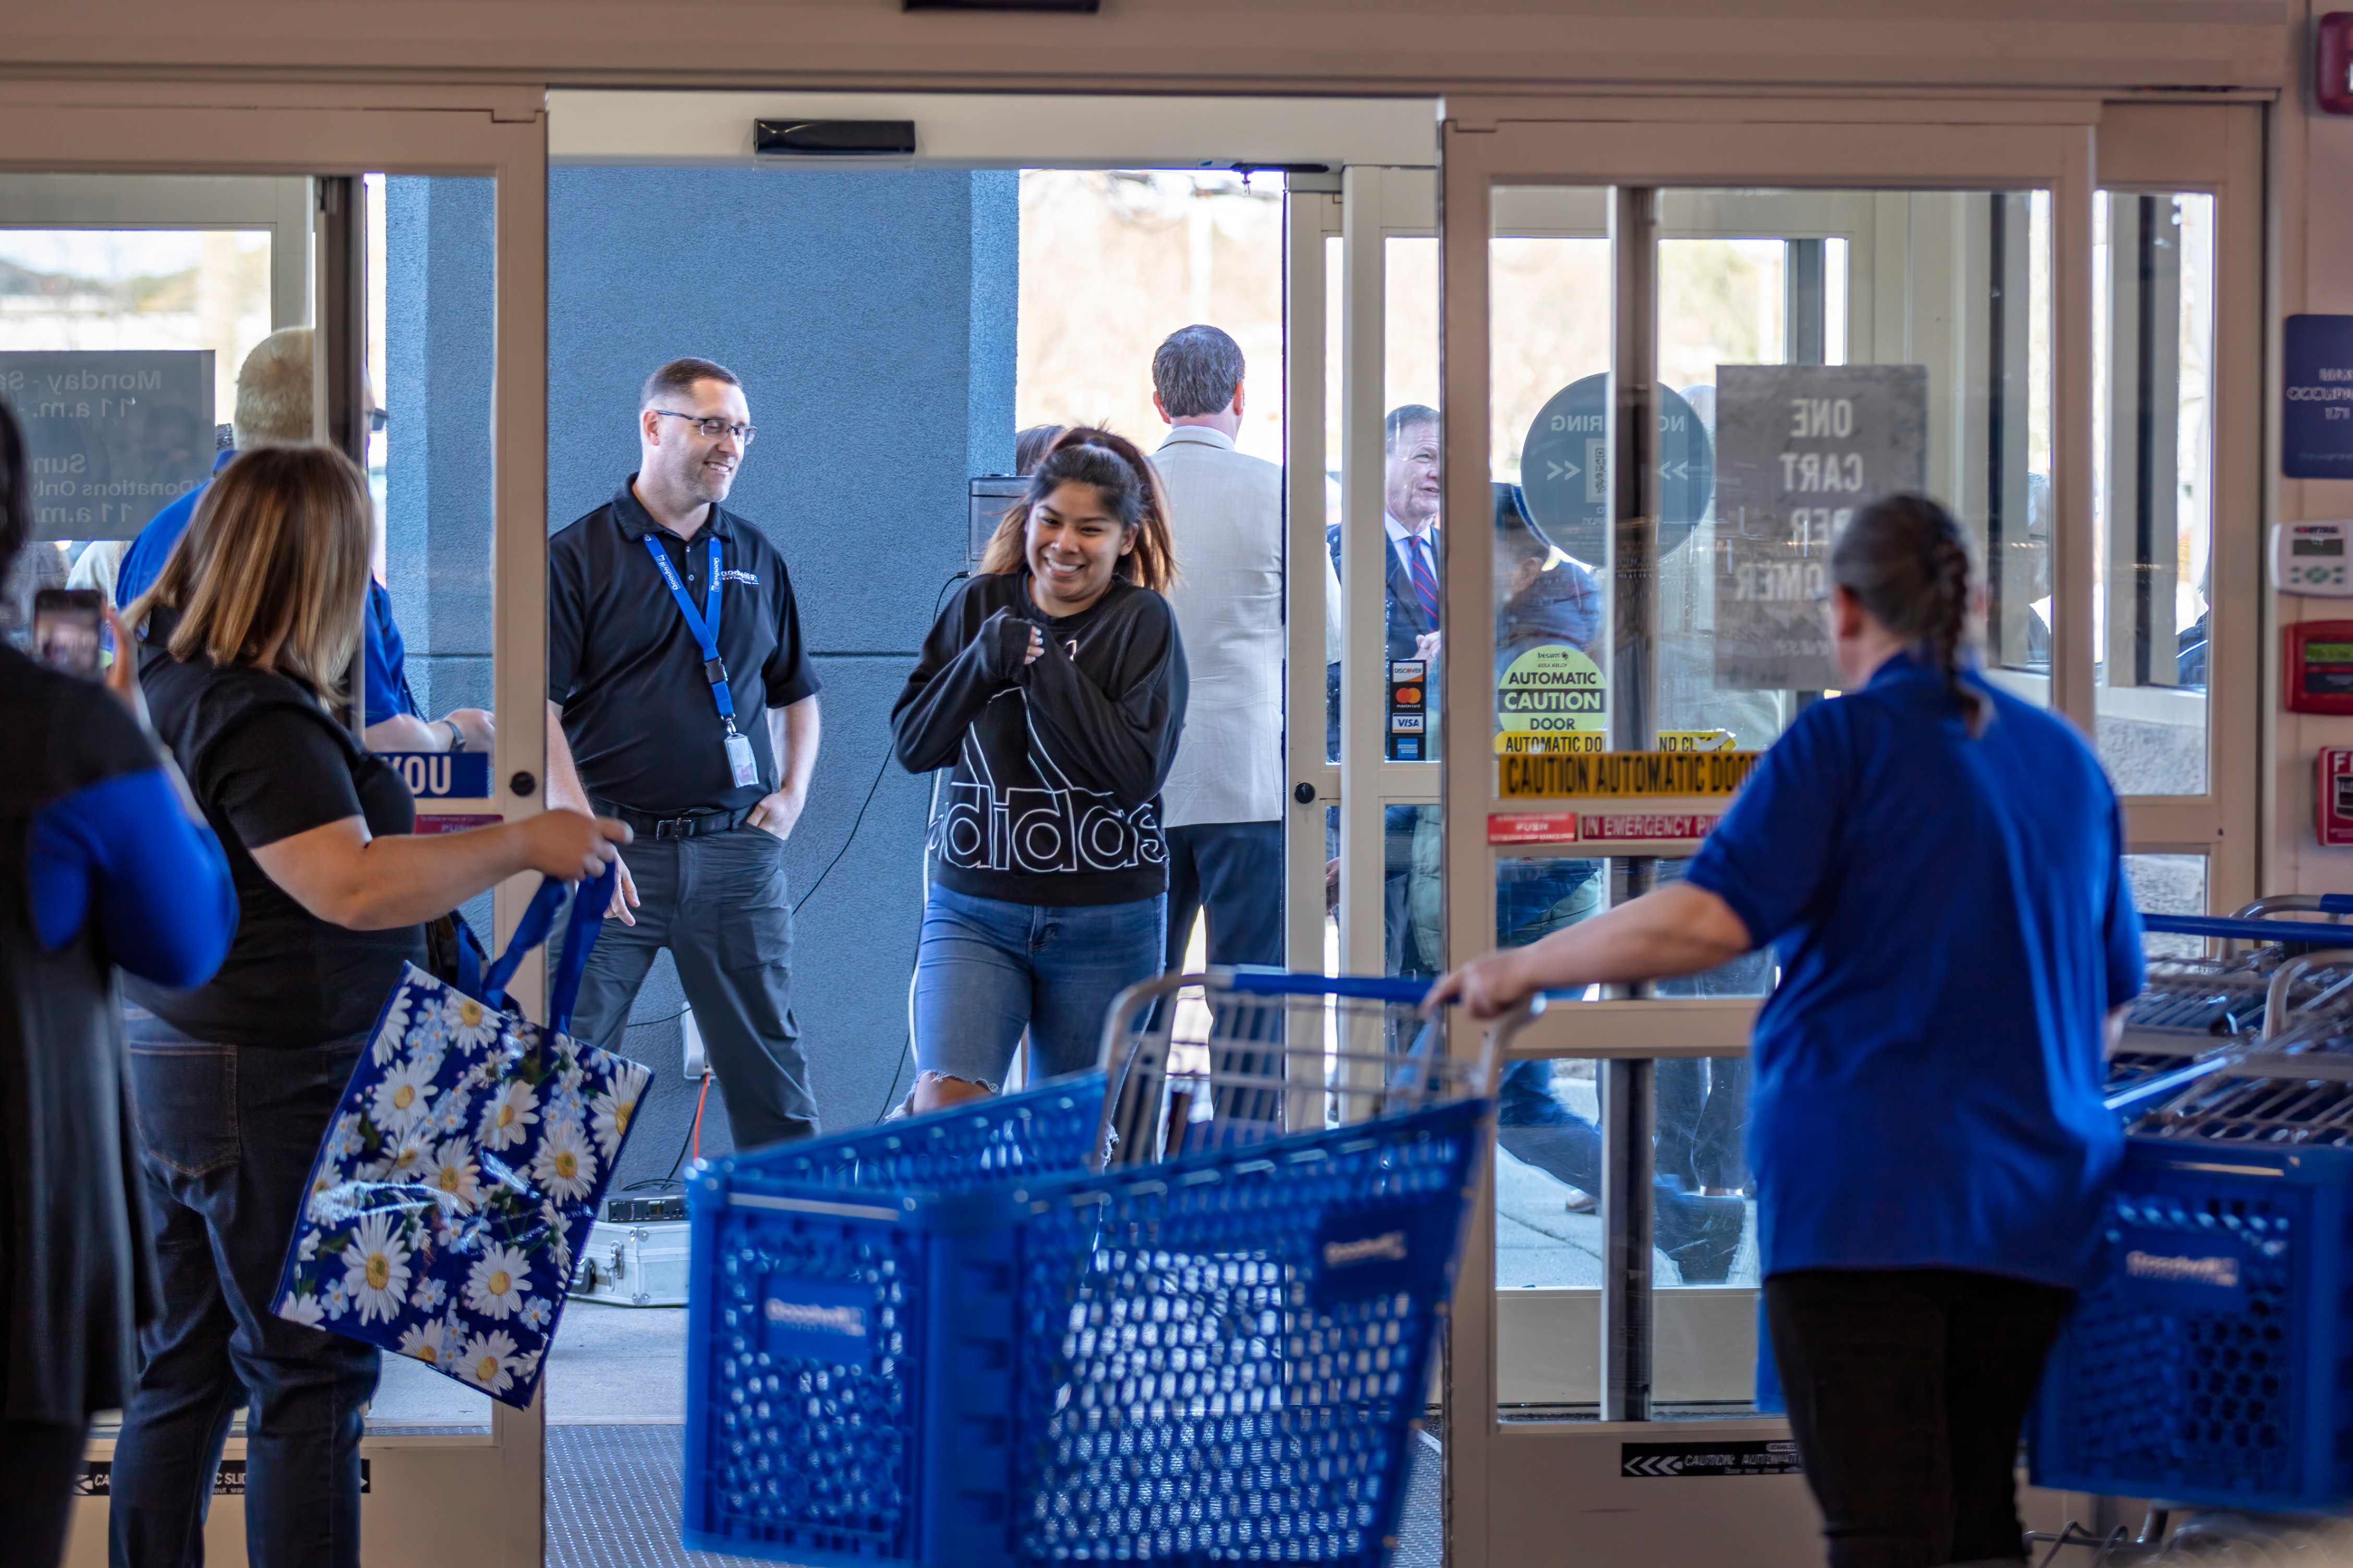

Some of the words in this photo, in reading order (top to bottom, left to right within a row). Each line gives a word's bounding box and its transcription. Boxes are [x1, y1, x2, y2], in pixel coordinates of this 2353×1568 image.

[1509, 672, 1597, 685] AUTOMATIC
[1505, 691, 1600, 710] CAUTION
[1398, 719, 1420, 727] VISA
[1530, 718, 1575, 731] DOOR
[1506, 736, 1580, 752] AUTOMATIC
[1585, 736, 1607, 752] DO
[1507, 756, 1590, 793] CAUTION
[1597, 756, 1705, 793] AUTOMATIC
[927, 782, 1170, 872] adidas
[1586, 816, 1599, 836] IN
[1604, 815, 1694, 836] EMERGENCY
